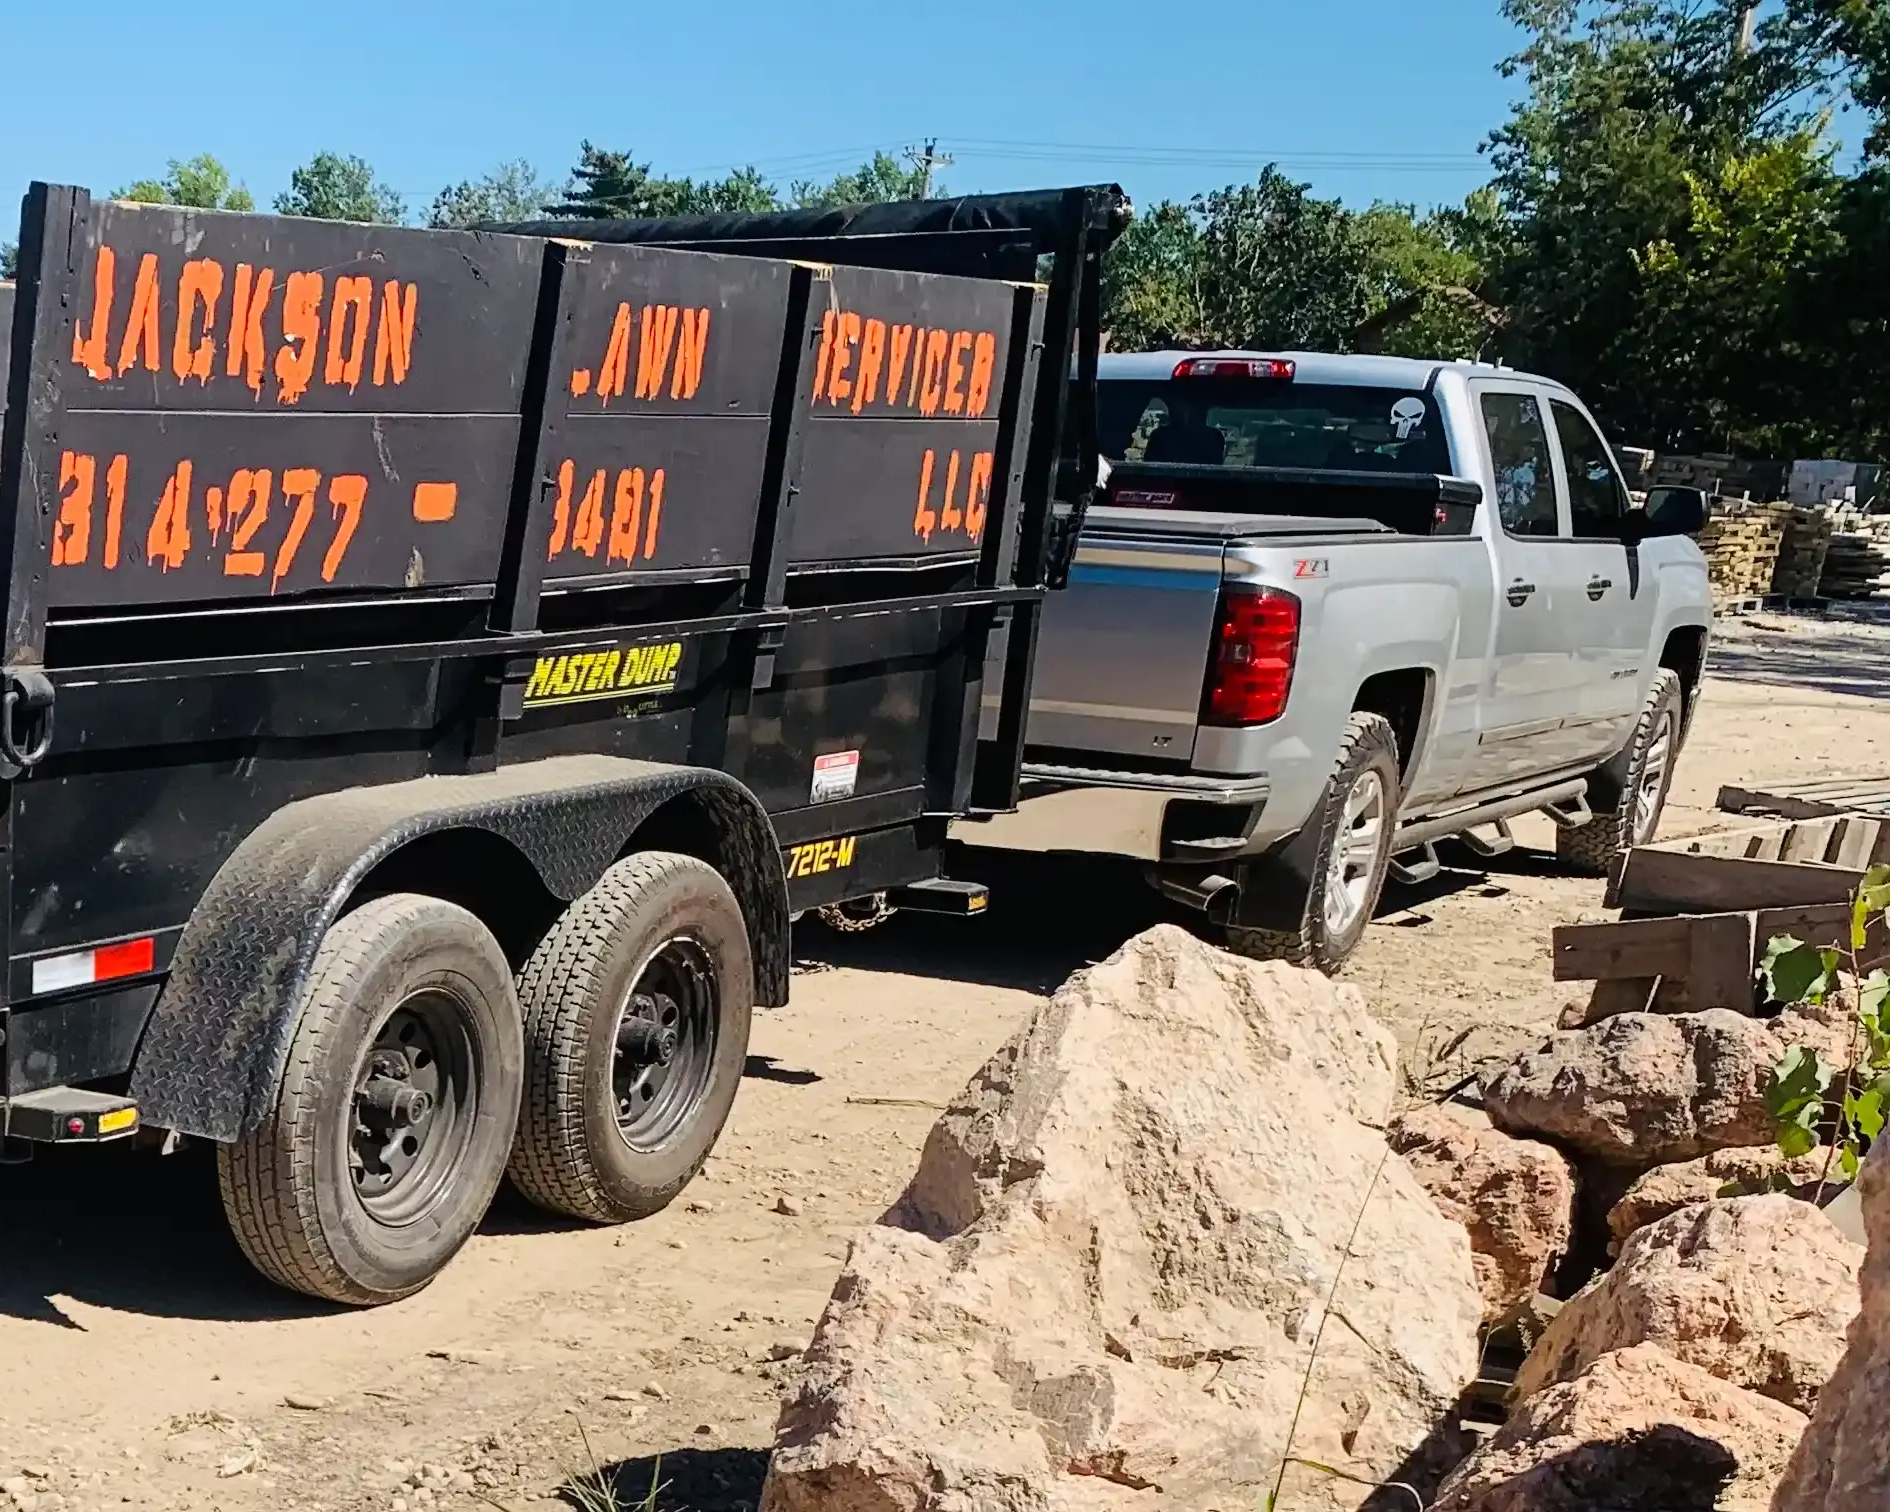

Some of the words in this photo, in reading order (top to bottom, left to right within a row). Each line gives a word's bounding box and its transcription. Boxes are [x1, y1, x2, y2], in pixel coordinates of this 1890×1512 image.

[71, 245, 417, 403] JACKSON
[570, 302, 710, 407] AWN
[914, 449, 994, 545] LLC
[1294, 559, 1329, 577] Z71
[524, 650, 620, 698] MASTER
[618, 643, 682, 687] DUMP
[787, 836, 856, 879] 7212-M
